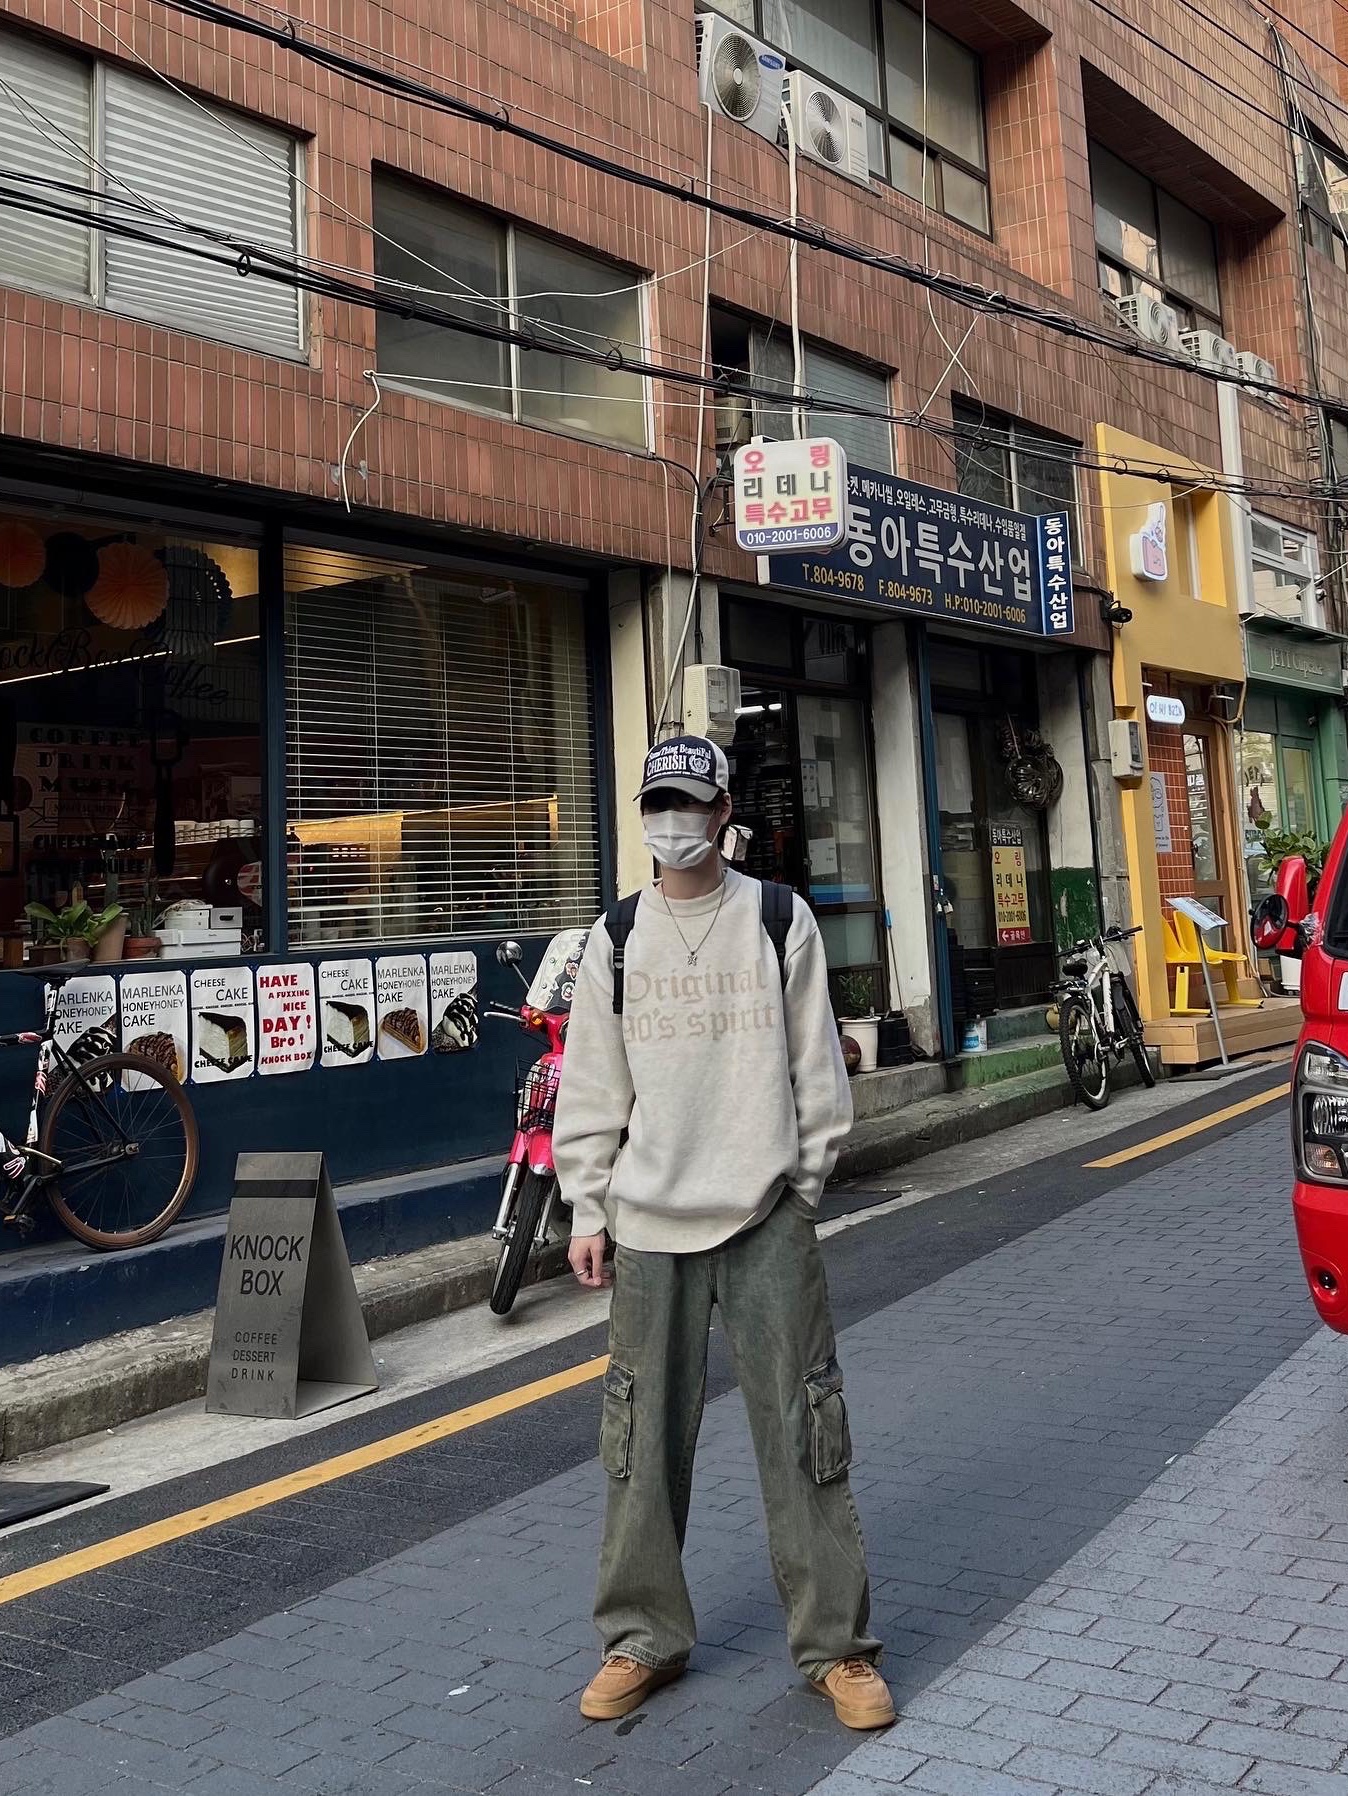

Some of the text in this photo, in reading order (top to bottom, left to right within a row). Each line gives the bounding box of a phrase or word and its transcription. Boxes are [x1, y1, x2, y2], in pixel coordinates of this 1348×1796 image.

[744, 497, 833, 526] 특수고무
[745, 526, 832, 545] 010-2001-6006
[846, 503, 1032, 602] 동아특수산업
[1043, 516, 1068, 631] 동아특수산업
[802, 562, 865, 593] T.804-9678
[878, 578, 934, 606] F.804-9673
[646, 754, 688, 777] CHERISH
[997, 893, 1025, 908] 특수고무
[321, 969, 350, 979] CHEESE
[377, 966, 426, 979] MARLENKA
[431, 963, 476, 976] MARLENKA
[194, 978, 226, 989] CHEESE
[259, 975, 299, 989] HAVE
[340, 978, 370, 992] CAKE
[626, 959, 768, 1004] Original
[57, 991, 114, 1006] ARLENKA
[122, 984, 184, 1000] MARLENKA
[216, 987, 249, 1002] CAKE
[268, 992, 276, 1000] A
[276, 989, 311, 999] FUXXING
[377, 991, 404, 1004] CAKE
[431, 988, 456, 1000] CAKE
[283, 1001, 307, 1012] NICE
[55, 1021, 83, 1035] AKE
[122, 1013, 156, 1028] CAKE
[294, 1051, 313, 1062] BOX
[229, 1234, 305, 1262] KNOCK
[240, 1269, 285, 1296] BOX
[234, 1331, 278, 1346] COFFEE
[232, 1349, 277, 1364] DESSERT
[230, 1367, 276, 1382] DRINK
